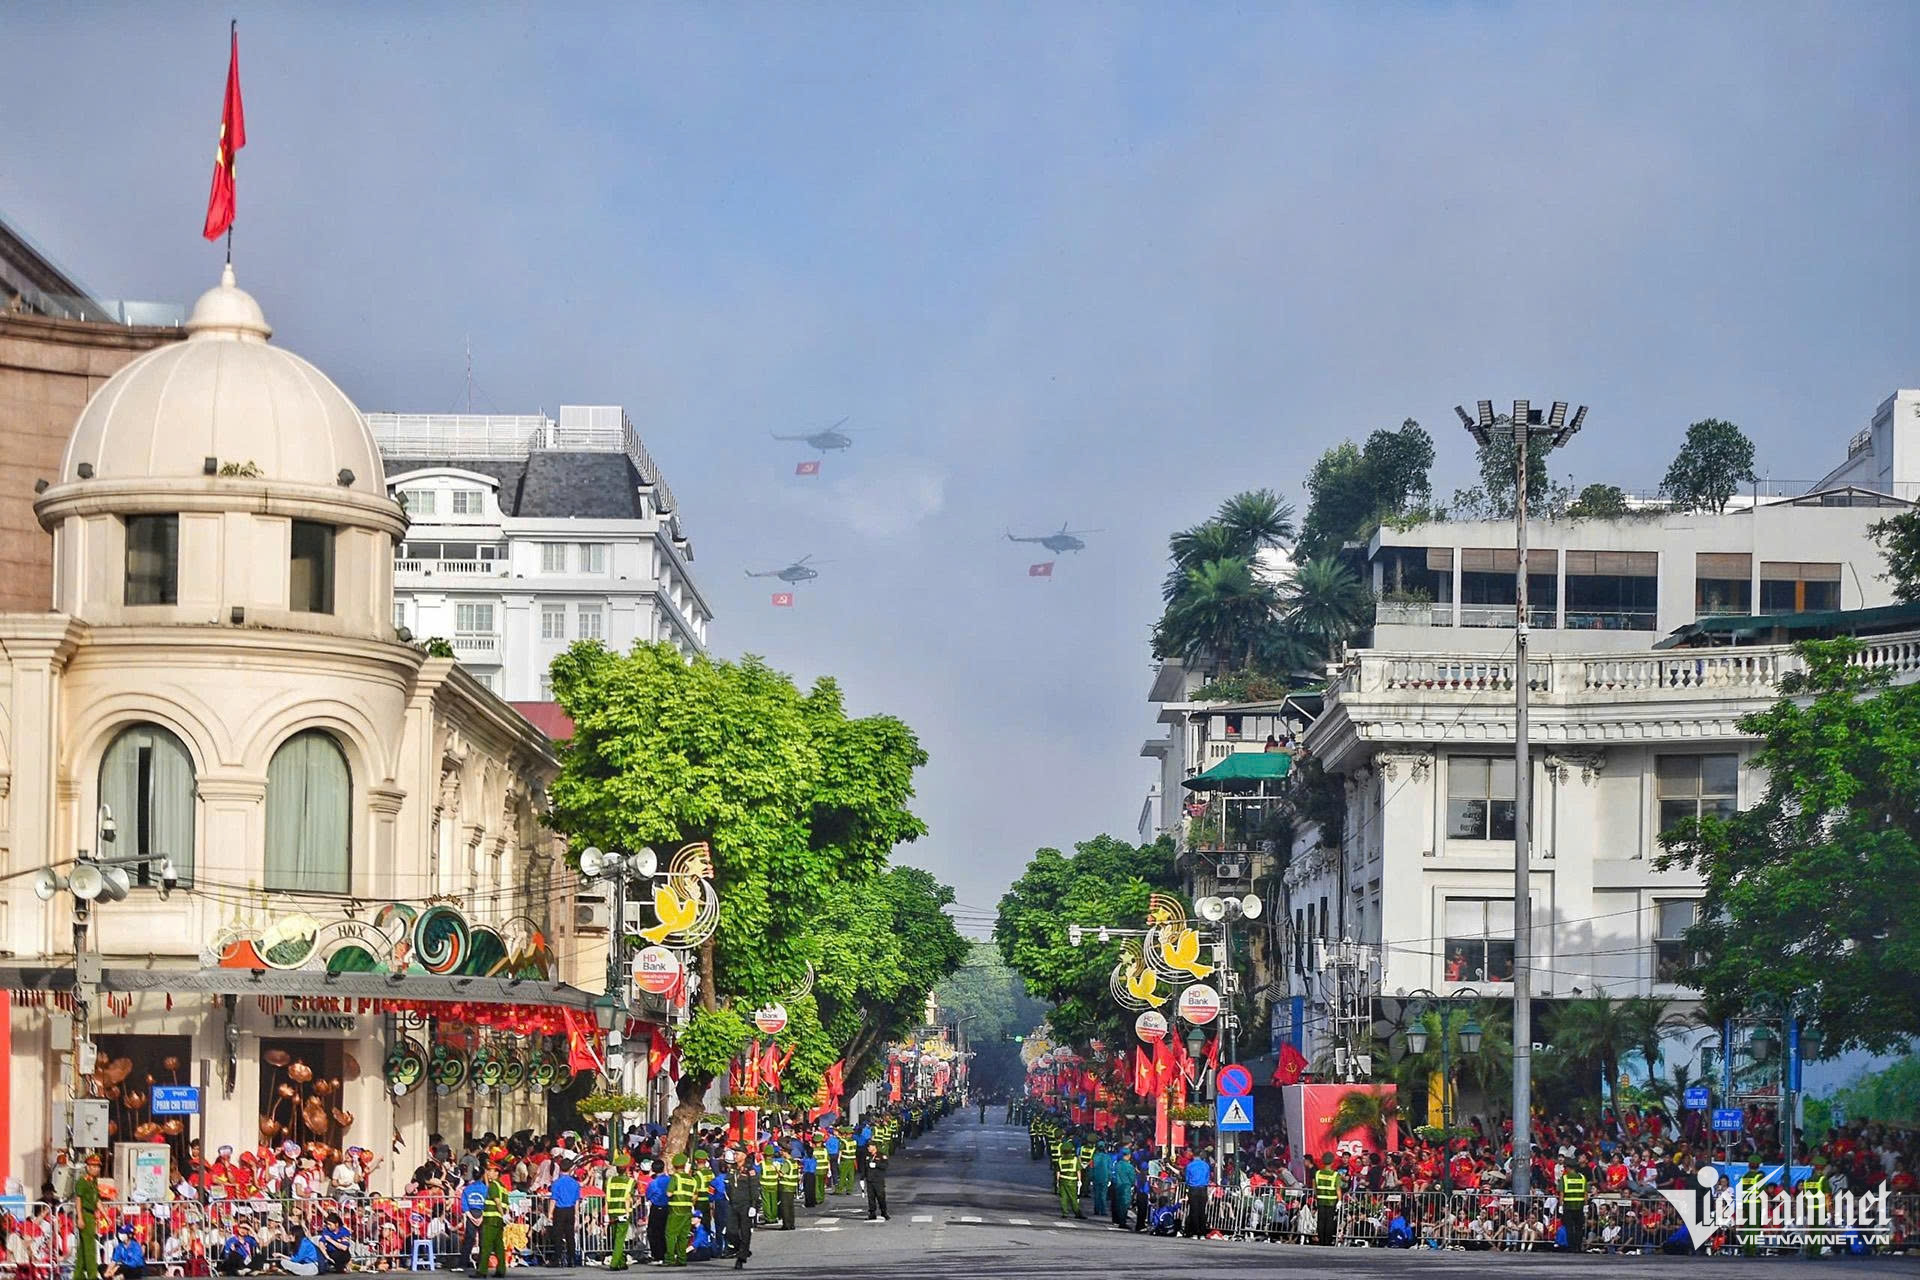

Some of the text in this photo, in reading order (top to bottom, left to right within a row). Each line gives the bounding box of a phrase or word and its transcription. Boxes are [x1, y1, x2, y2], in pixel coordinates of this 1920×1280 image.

[337, 925, 367, 938] HNX
[642, 953, 657, 962] HD
[642, 962, 666, 971] Bank
[1188, 997, 1208, 1005] Bank
[273, 1014, 355, 1030] EXCHANGE
[1336, 1140, 1363, 1157] 5G
